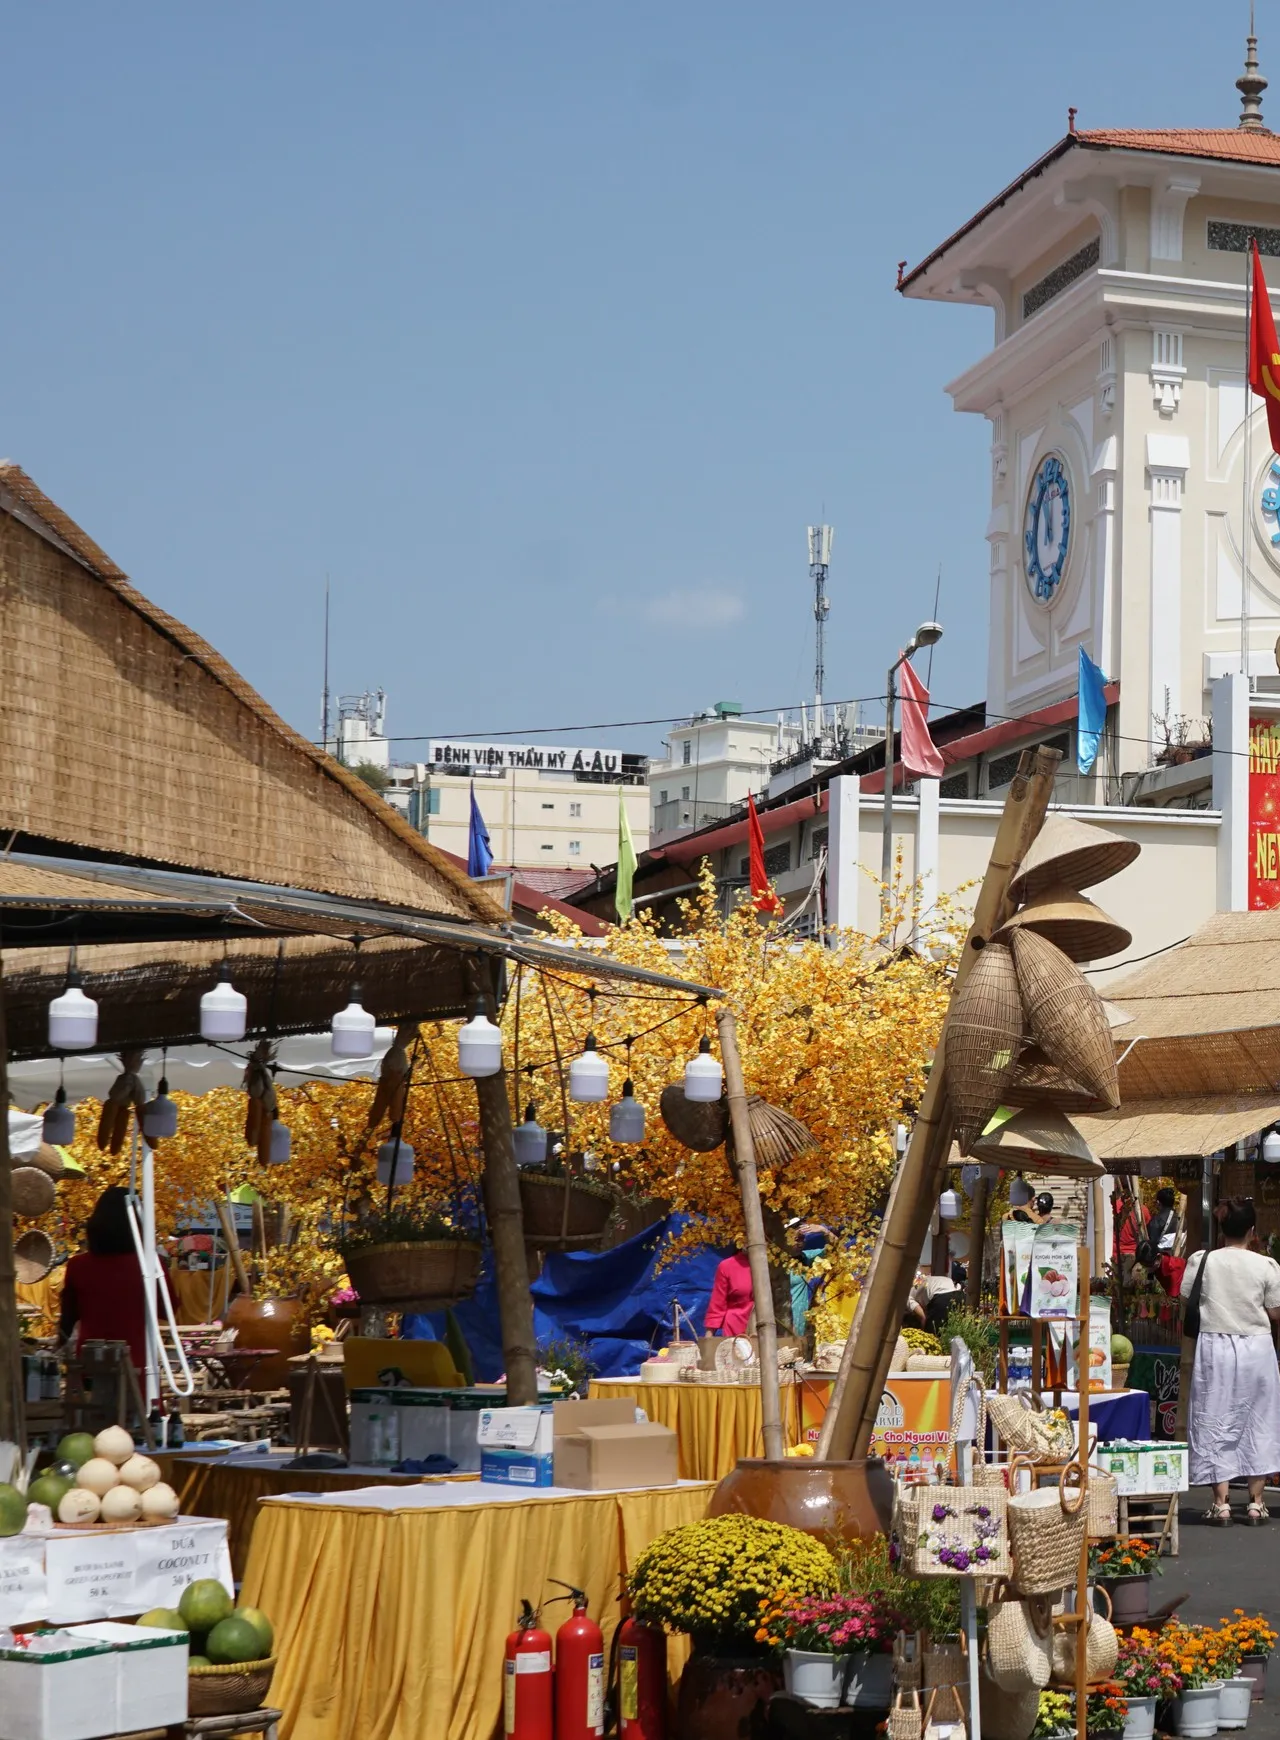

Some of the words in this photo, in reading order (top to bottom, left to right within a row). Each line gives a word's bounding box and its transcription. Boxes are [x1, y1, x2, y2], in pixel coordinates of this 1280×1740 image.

[435, 745, 470, 764] BỆNH
[474, 747, 503, 766] VIỆN
[508, 747, 543, 767] THẨM
[883, 1430, 903, 1441] Cho
[158, 1553, 209, 1570] COCONUT
